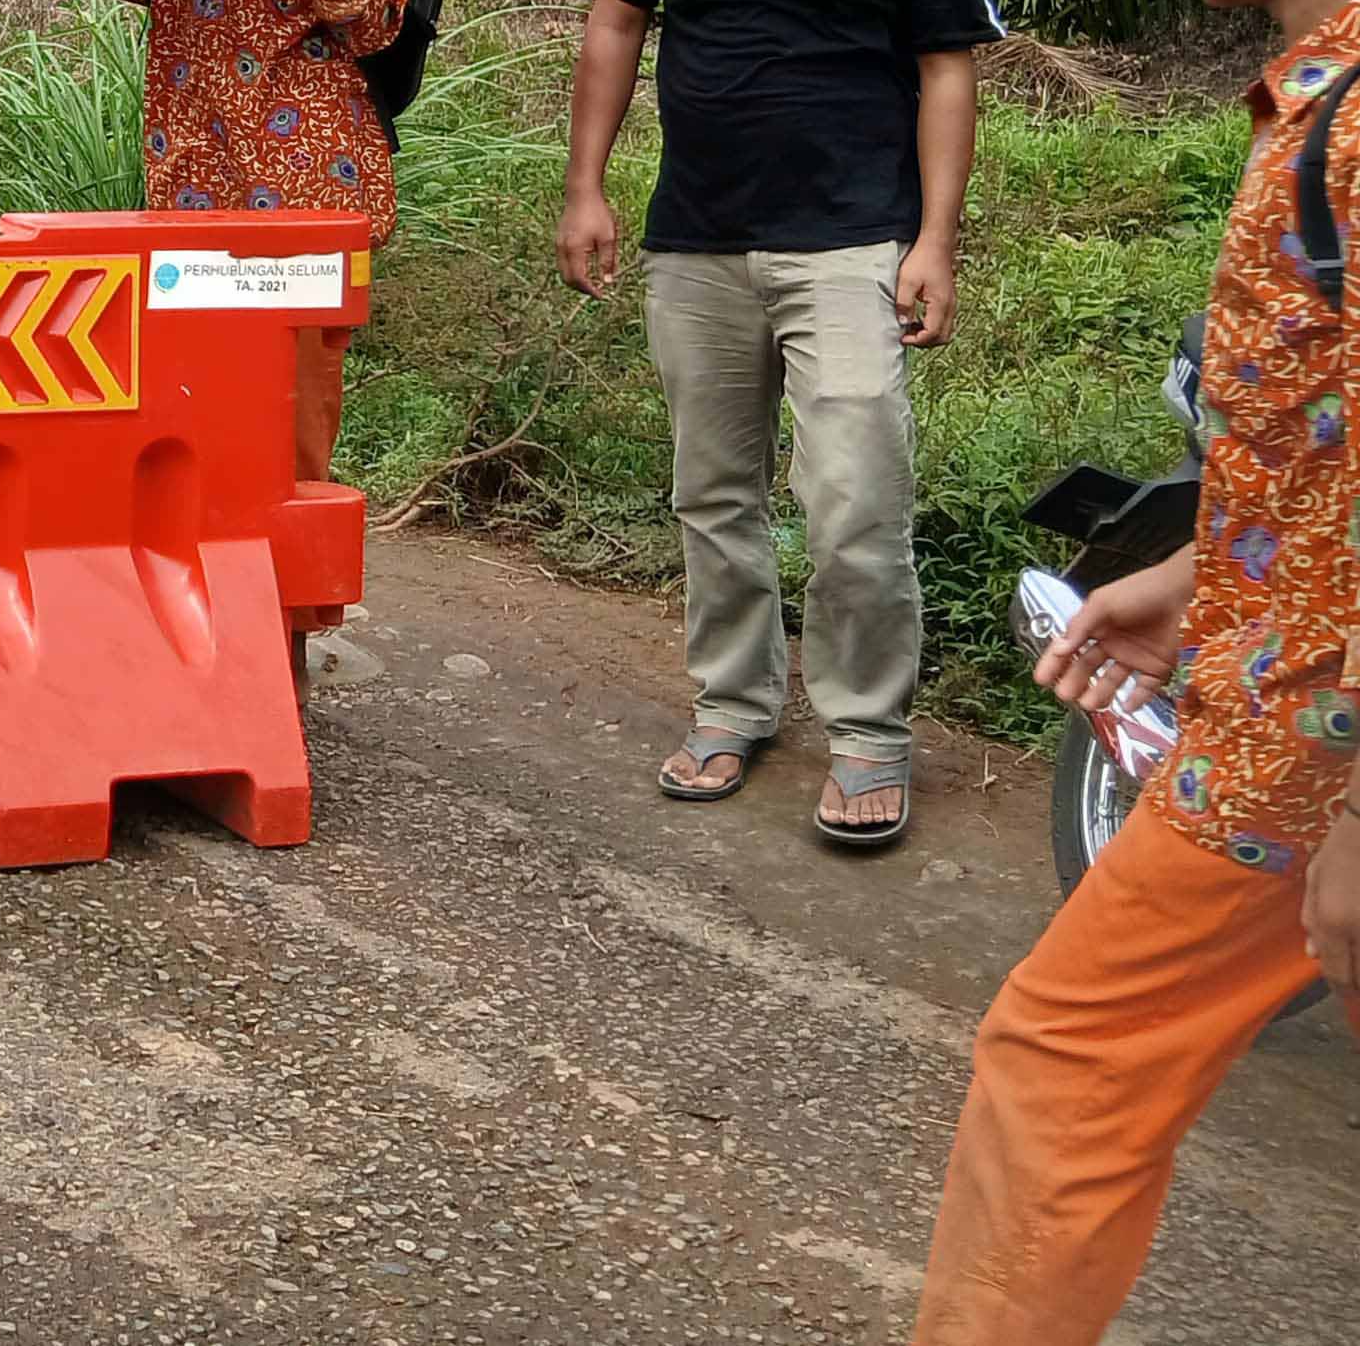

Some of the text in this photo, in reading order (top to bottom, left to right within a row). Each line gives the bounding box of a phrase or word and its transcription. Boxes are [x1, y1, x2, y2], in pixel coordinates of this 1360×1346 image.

[183, 264, 339, 277] PERHUBUNGAN SELUMA
[234, 279, 288, 293] TA. 2021
